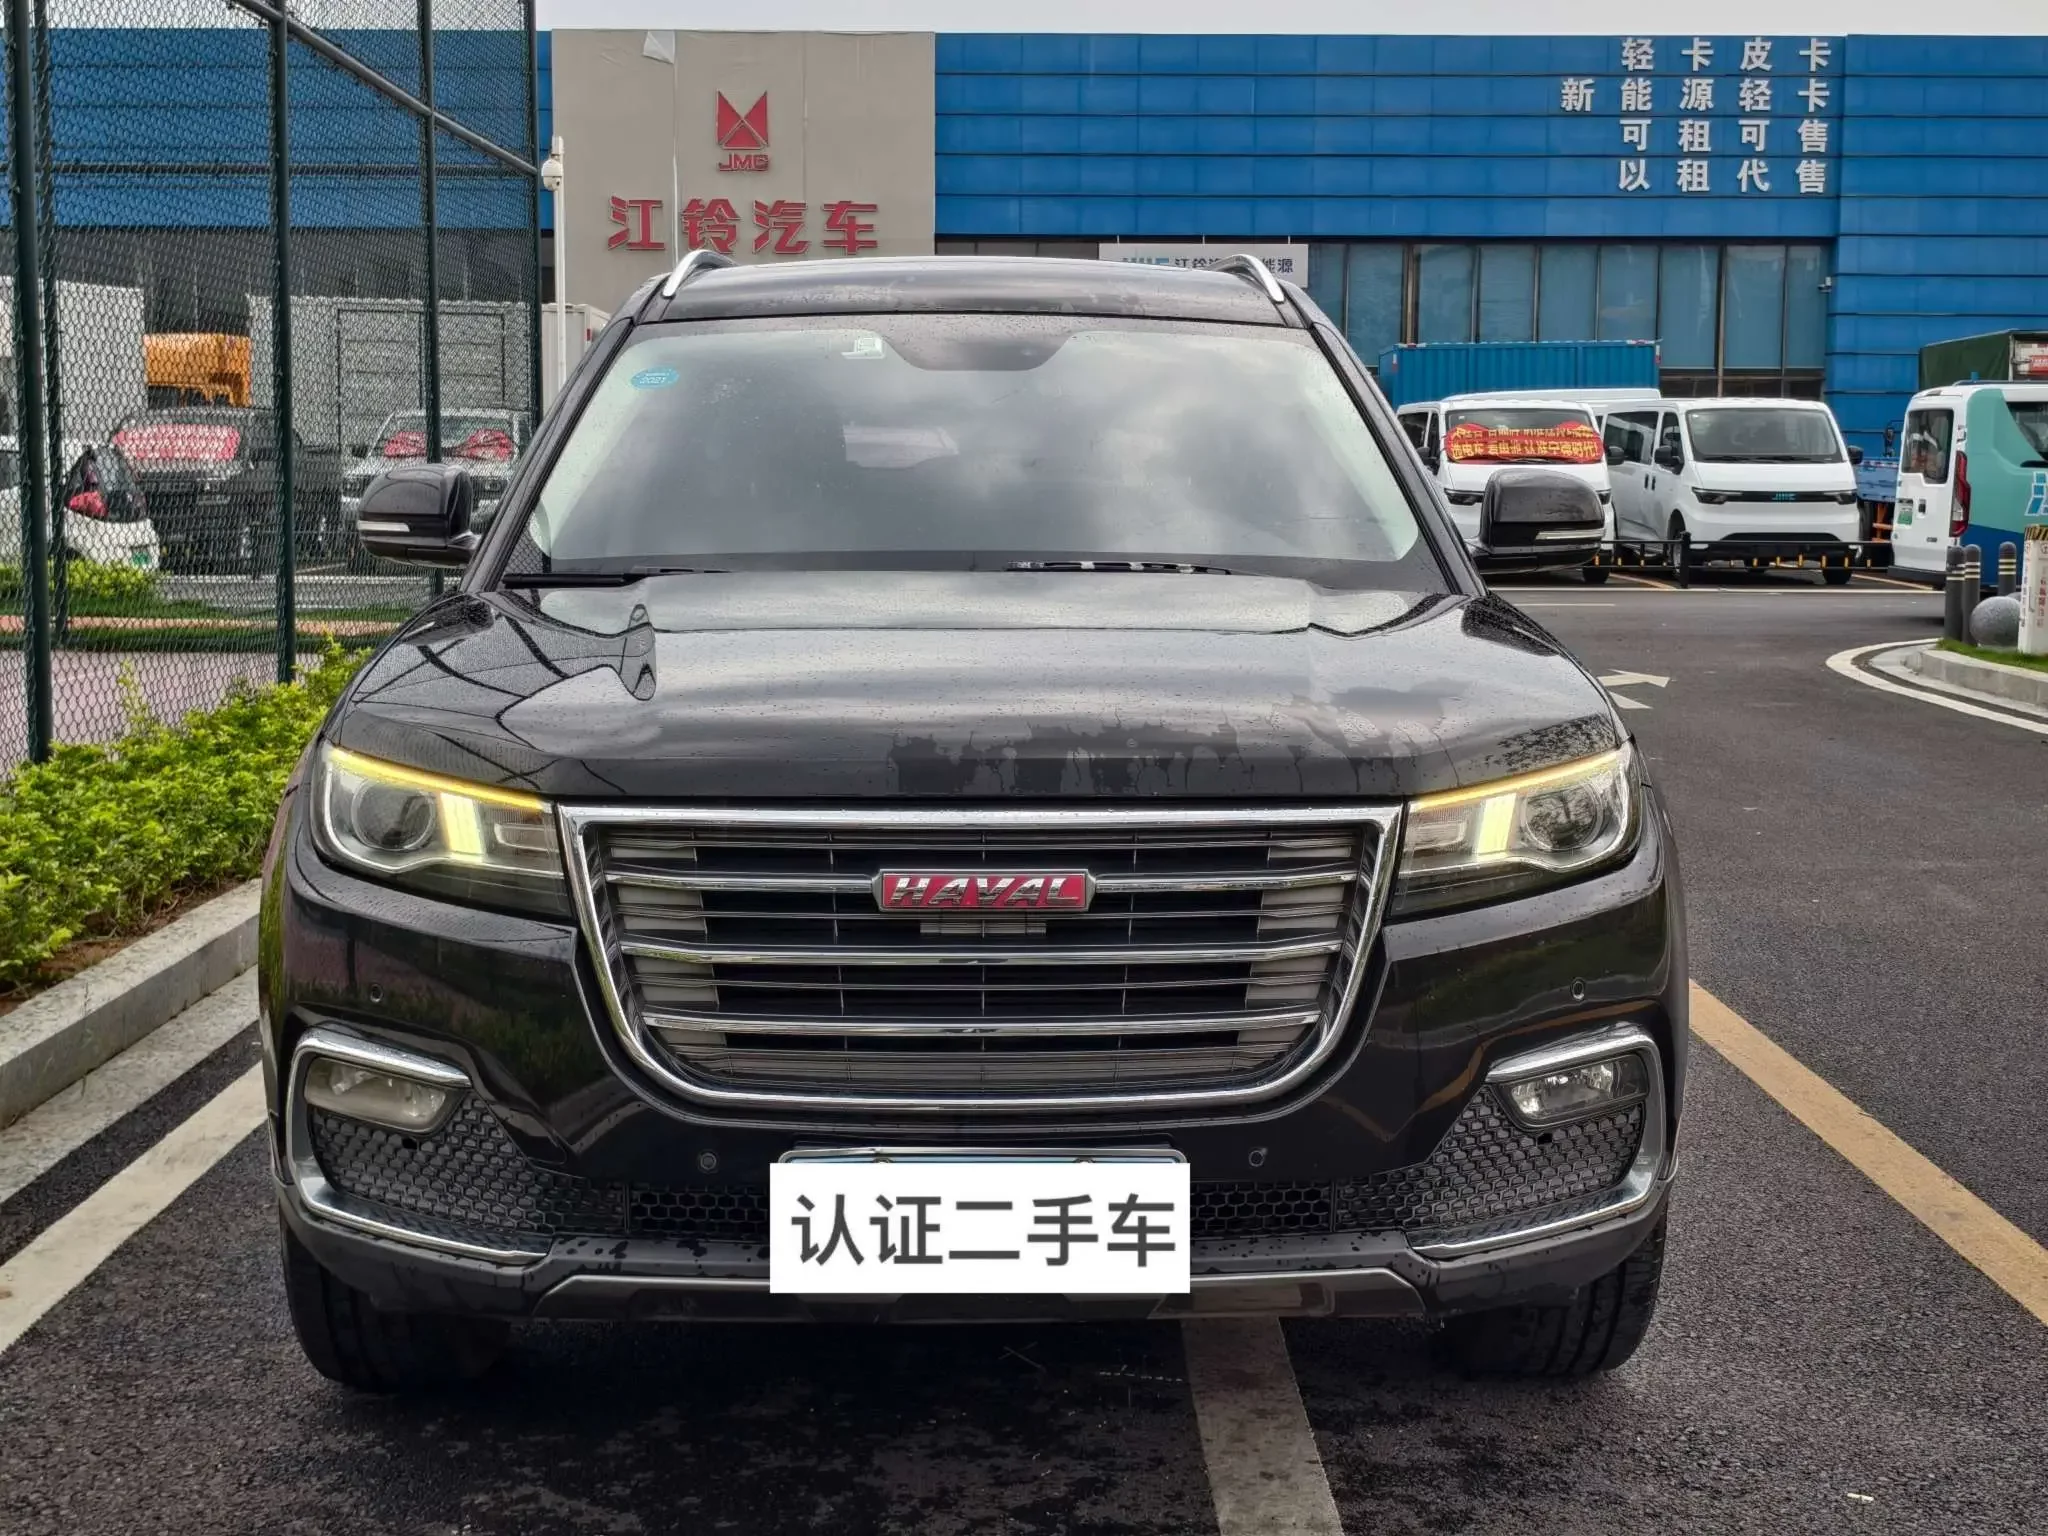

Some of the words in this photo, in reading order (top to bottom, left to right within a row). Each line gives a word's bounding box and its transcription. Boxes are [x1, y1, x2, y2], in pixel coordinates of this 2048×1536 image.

[1621, 37, 1832, 72] 轻卡皮卡
[1560, 78, 1830, 112] 新能源轻卡
[1619, 119, 1829, 153] 可租可售
[718, 153, 769, 171] JMC
[1618, 159, 1827, 193] 以租代售
[608, 195, 878, 254] 江铃汽车
[890, 877, 1080, 905] HAVAL
